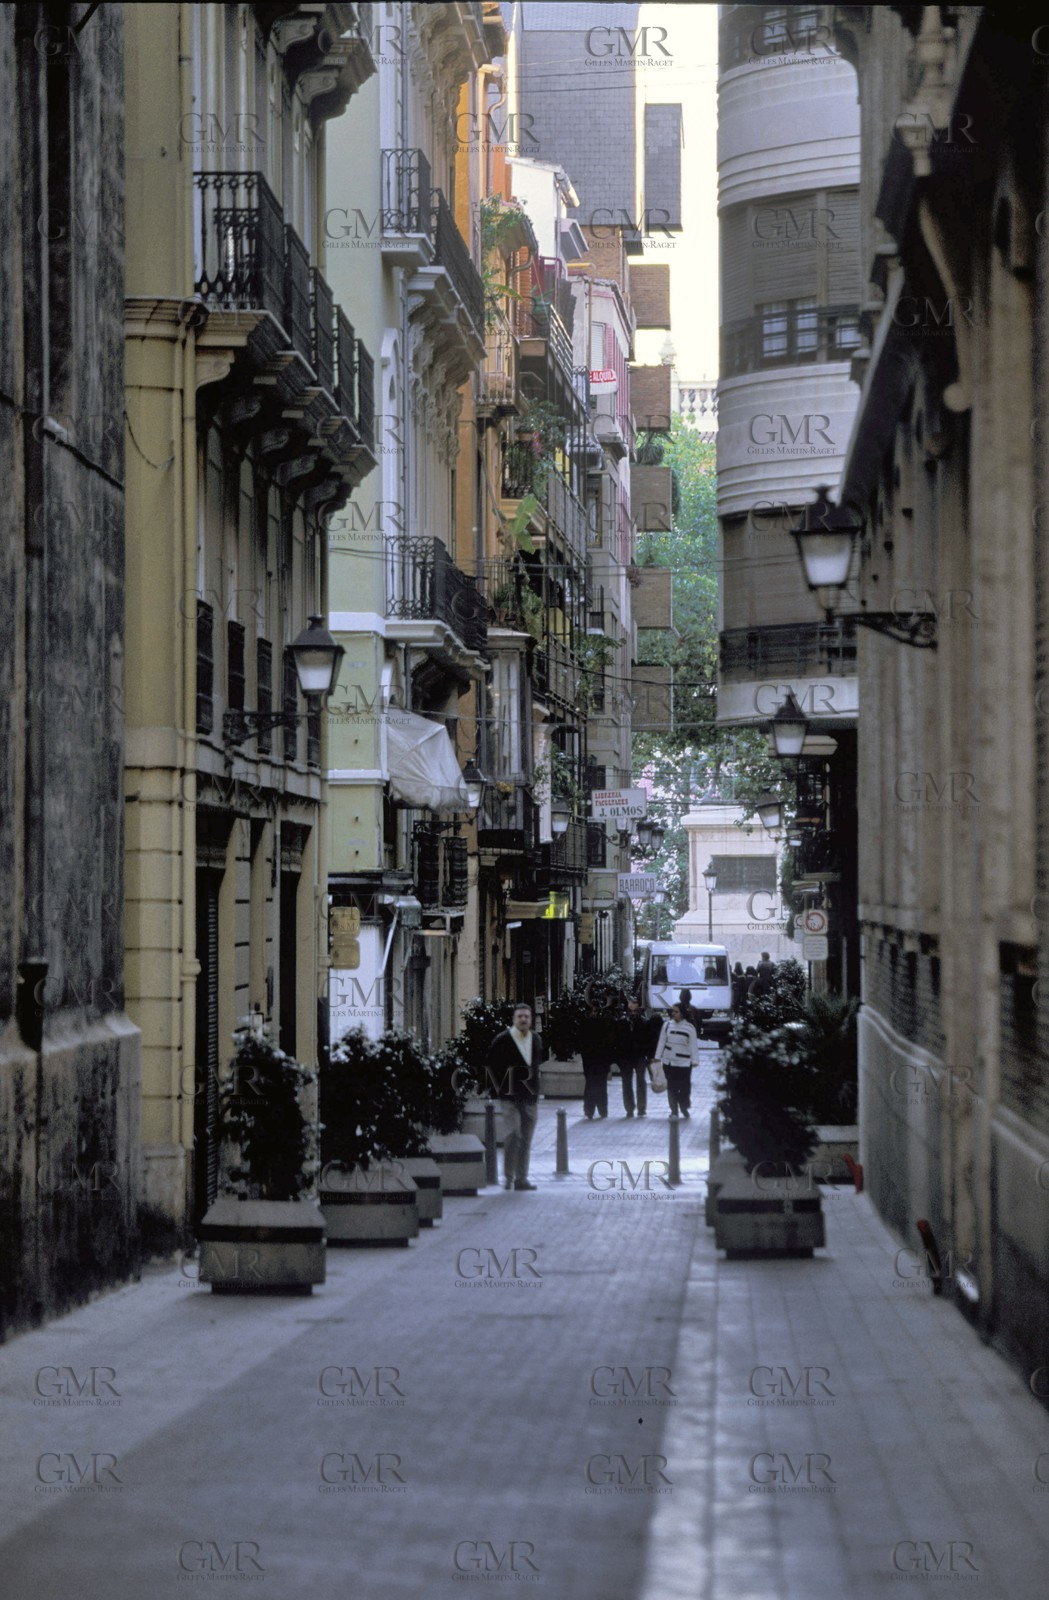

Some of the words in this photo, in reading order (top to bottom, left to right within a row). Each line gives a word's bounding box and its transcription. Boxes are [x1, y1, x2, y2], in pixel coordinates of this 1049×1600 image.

[599, 808, 607, 817] J.
[610, 805, 643, 817] OLMOS
[619, 878, 655, 892] BARROCO
